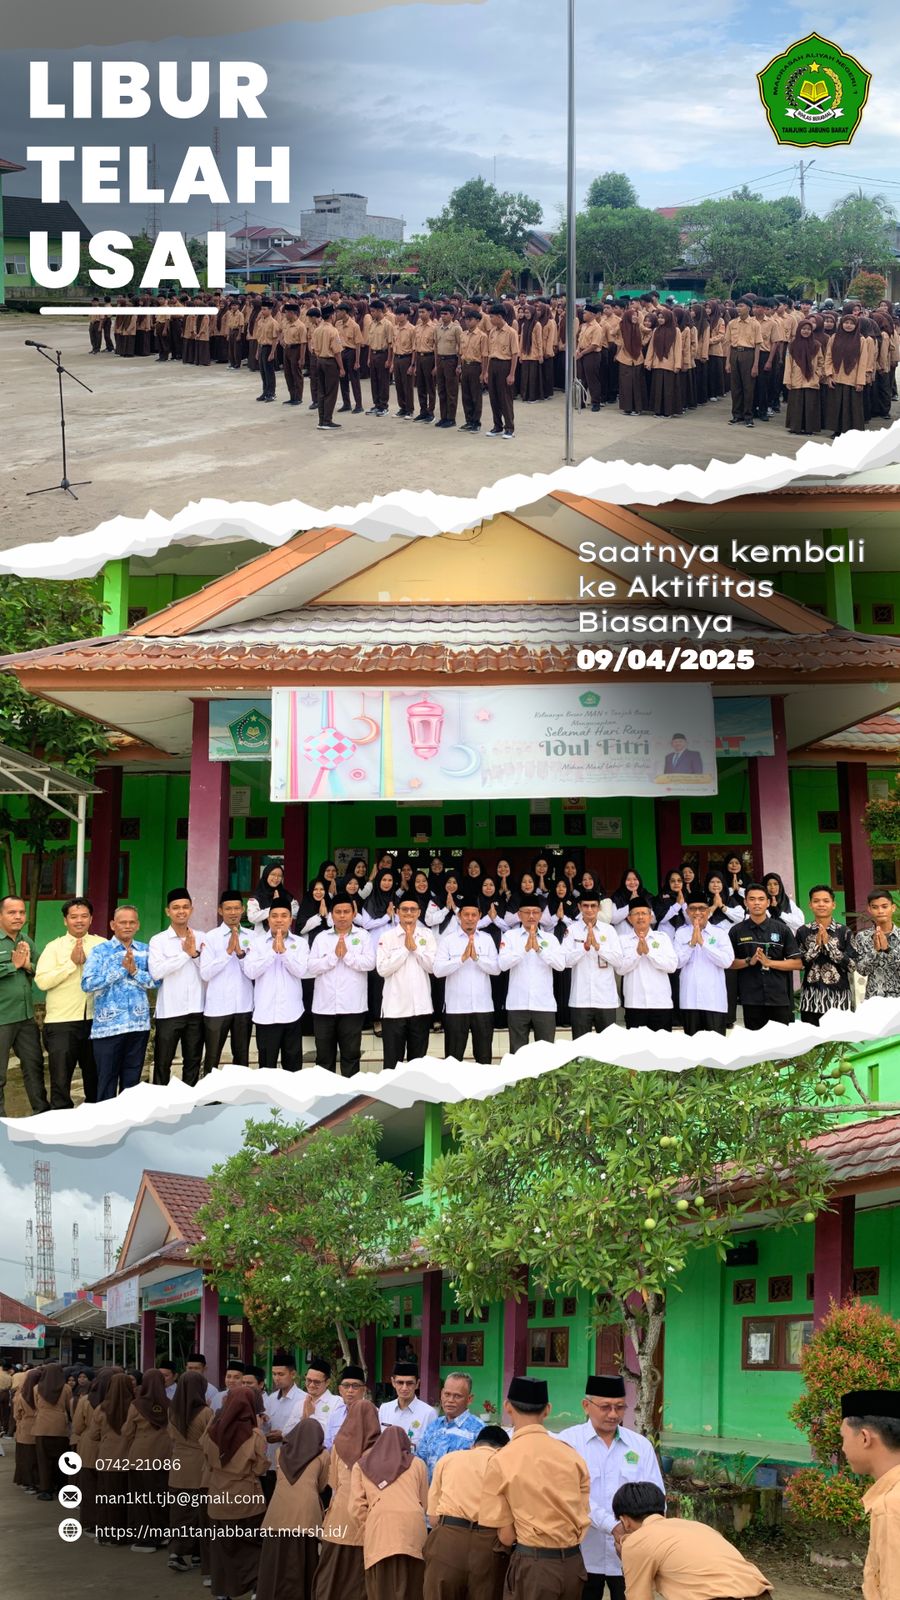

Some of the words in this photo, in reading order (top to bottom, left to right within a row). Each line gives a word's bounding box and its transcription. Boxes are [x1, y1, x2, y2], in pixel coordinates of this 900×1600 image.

[545, 726, 591, 737] Selamat
[595, 726, 620, 736] Hari
[623, 725, 652, 739] Raya
[539, 739, 589, 757] Idul
[596, 738, 650, 756] Fitri
